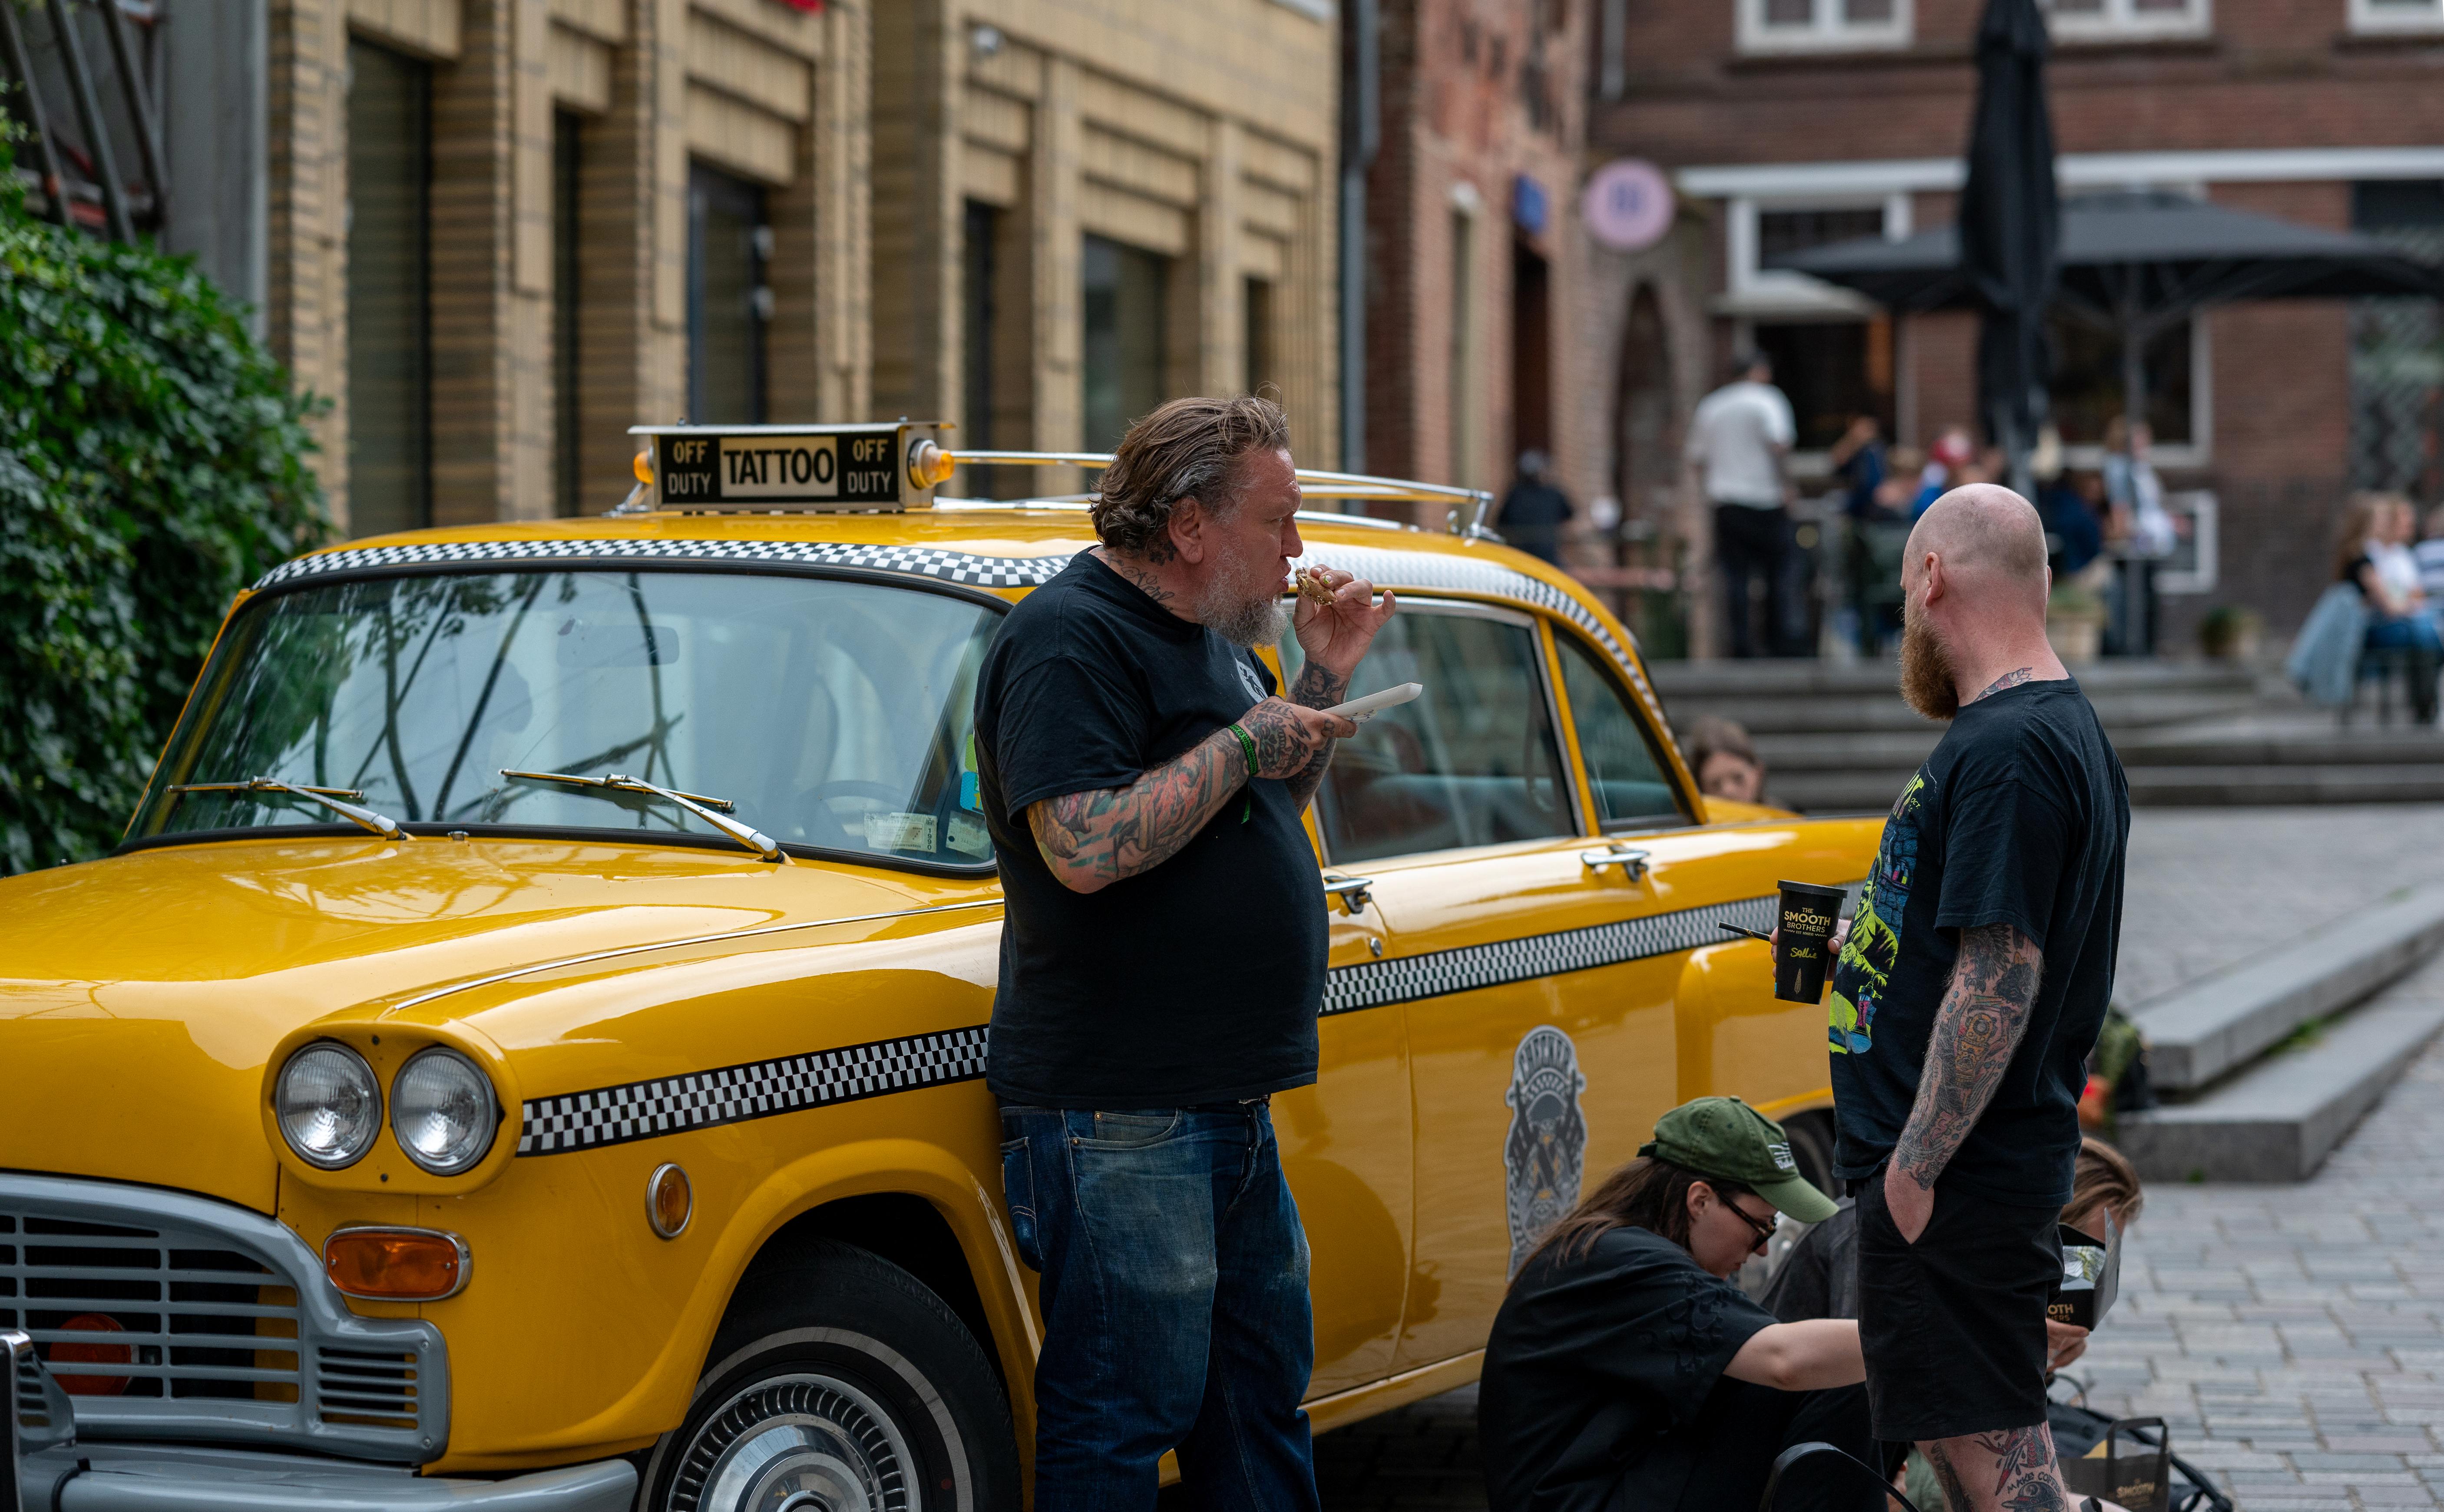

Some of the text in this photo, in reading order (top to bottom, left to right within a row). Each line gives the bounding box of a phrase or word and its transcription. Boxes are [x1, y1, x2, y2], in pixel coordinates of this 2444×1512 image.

[673, 441, 708, 464] OFF
[852, 439, 889, 462] OFF
[724, 448, 834, 485] TATTOO
[668, 472, 711, 495] DUTY
[847, 471, 893, 494] DUTY
[1911, 798, 1921, 809] OCT.
[1784, 911, 1831, 926] SMOOTH
[1787, 921, 1826, 933] BROTHERS
[2048, 1304, 2074, 1315] OTH
